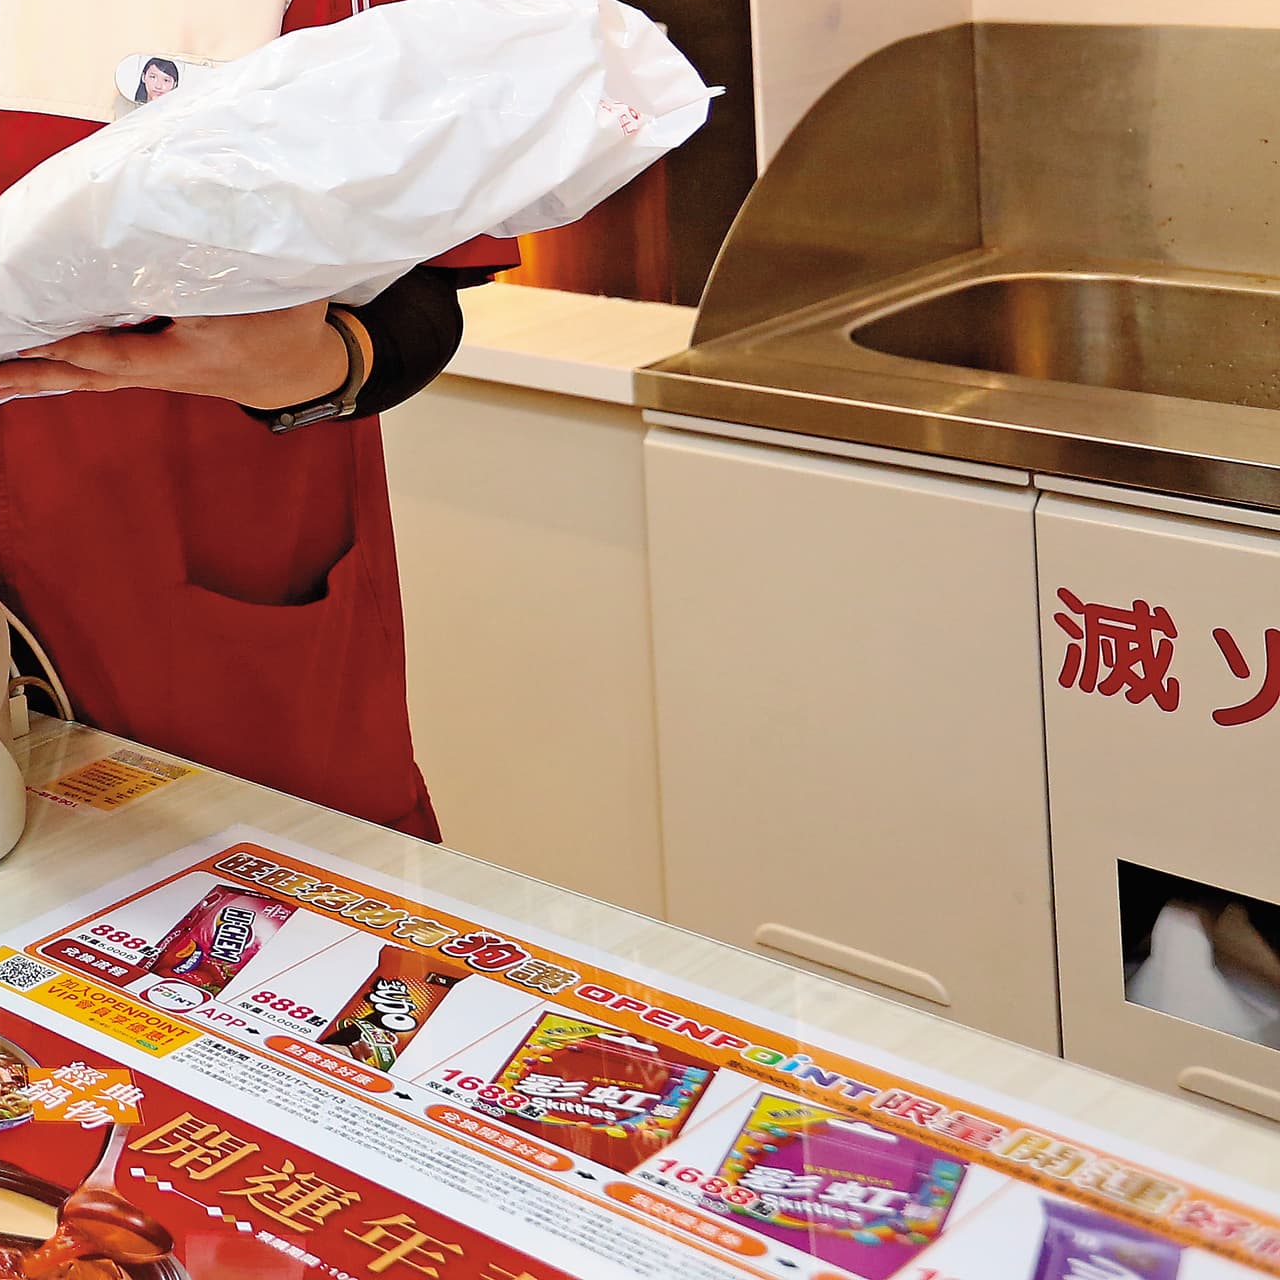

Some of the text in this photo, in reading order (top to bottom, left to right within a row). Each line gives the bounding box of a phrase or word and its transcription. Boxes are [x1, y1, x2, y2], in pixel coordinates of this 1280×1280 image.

[59, 943, 130, 978] 兌換流程
[215, 850, 580, 995] 旺旺招財有狗讚
[574, 983, 878, 1101] OPENPOINT
[46, 985, 174, 1047] VIP會員享優惠!
[56, 976, 192, 1039] 加入OPENPOINT
[195, 1006, 248, 1029] APP
[514, 1073, 662, 1114] 彩虹
[530, 1096, 617, 1122] Skittles
